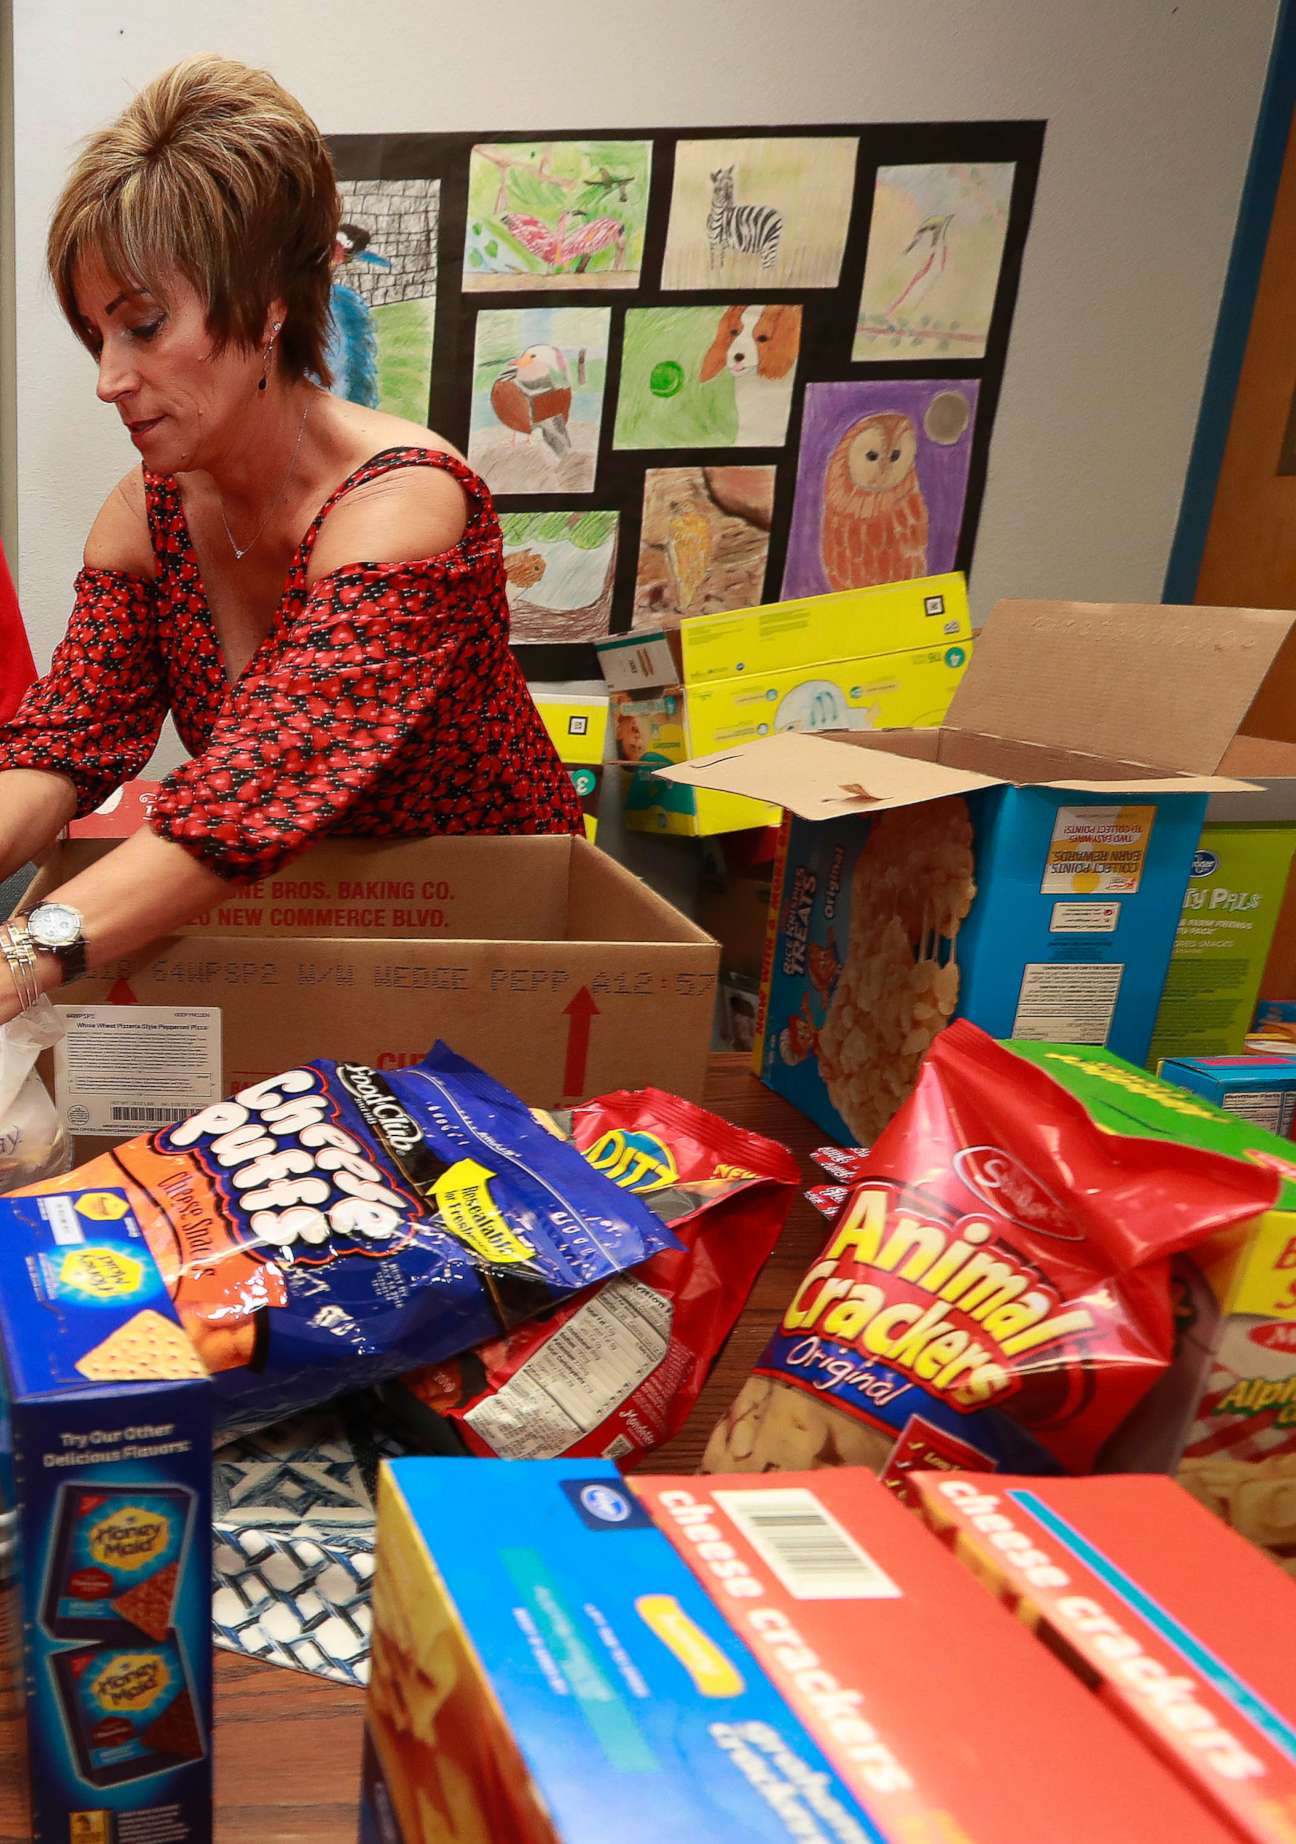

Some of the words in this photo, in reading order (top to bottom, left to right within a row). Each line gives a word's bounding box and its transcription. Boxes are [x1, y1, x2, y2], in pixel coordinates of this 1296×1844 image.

[1093, 862, 1138, 874] COLLECT
[1110, 850, 1143, 861] EARN
[271, 881, 331, 900] BROS.
[338, 881, 415, 900] BAKING
[421, 881, 455, 902] CO.
[218, 908, 264, 928] NEW
[270, 908, 386, 929] COMMERCE
[391, 908, 450, 929] BLVD.
[791, 872, 818, 976] TREATS
[373, 965, 471, 990] WEDGE
[489, 968, 570, 993] PEPP
[343, 1063, 384, 1109] Food
[370, 1103, 425, 1153] Club
[158, 1170, 204, 1221] Cheese
[448, 1204, 490, 1253] Fresh
[97, 1254, 133, 1286] Maid
[825, 1189, 1096, 1358] Animal
[782, 1259, 1011, 1407] Crackers
[785, 1335, 915, 1407] Original
[60, 1432, 88, 1449] Try
[89, 1428, 123, 1445] Our
[123, 1423, 175, 1441] Other
[43, 1448, 121, 1469] Delicious
[94, 1522, 163, 1547] Honey
[103, 1538, 155, 1558] Maid
[655, 1489, 768, 1600] cheese
[744, 1607, 917, 1794] crackers
[937, 1480, 1071, 1589] cheese
[1055, 1595, 1267, 1781] crackers
[96, 1659, 160, 1696] Honey
[111, 1675, 159, 1706] Maid
